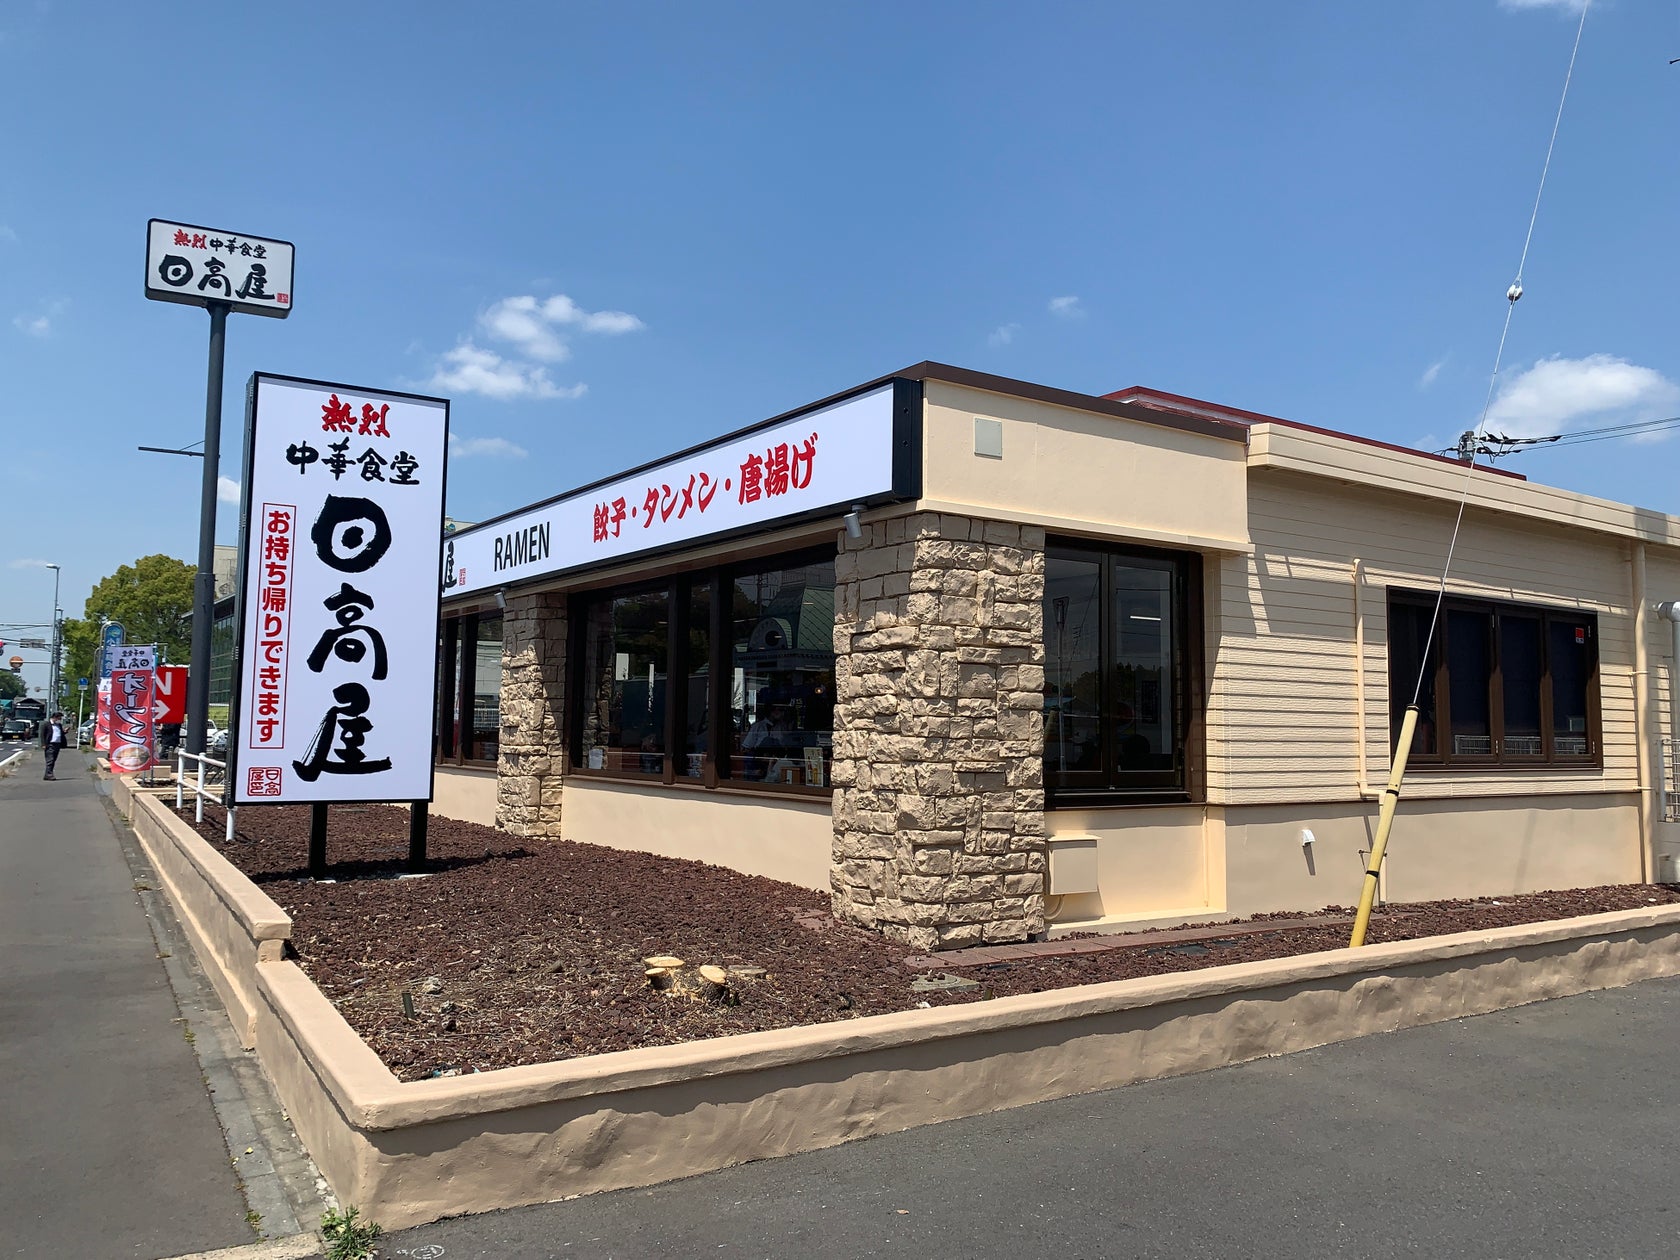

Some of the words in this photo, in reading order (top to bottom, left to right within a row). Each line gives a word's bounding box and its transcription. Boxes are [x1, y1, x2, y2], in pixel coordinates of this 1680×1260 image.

[158, 253, 276, 300] 日高屋
[321, 393, 391, 438] 熱烈
[285, 436, 420, 485] 中華食堂
[494, 521, 550, 572] RAMEN
[256, 510, 291, 743] お持ち帰りできます
[291, 493, 393, 783] 日高屋
